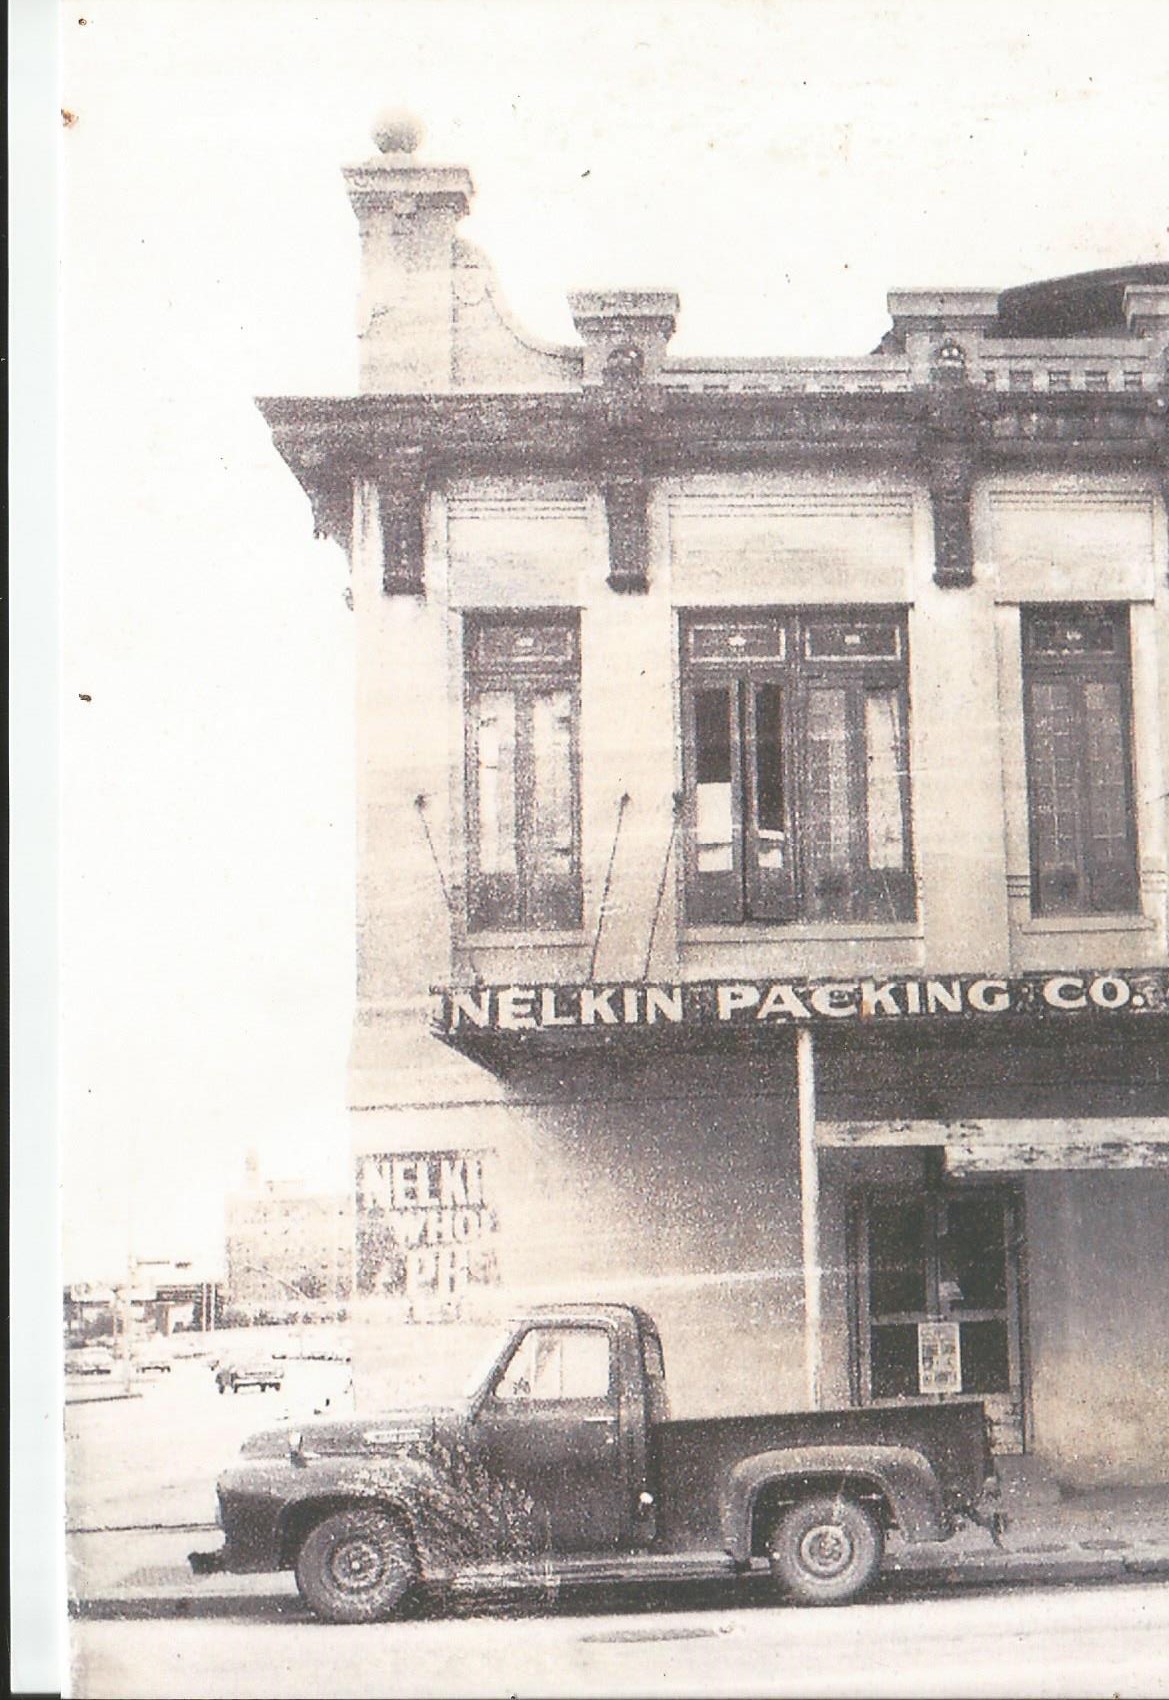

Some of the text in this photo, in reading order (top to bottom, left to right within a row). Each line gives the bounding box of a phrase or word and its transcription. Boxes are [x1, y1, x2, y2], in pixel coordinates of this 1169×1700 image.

[450, 985, 684, 1031] NELKIN
[717, 979, 1011, 1021] PACKING
[1043, 975, 1146, 1010] CO.
